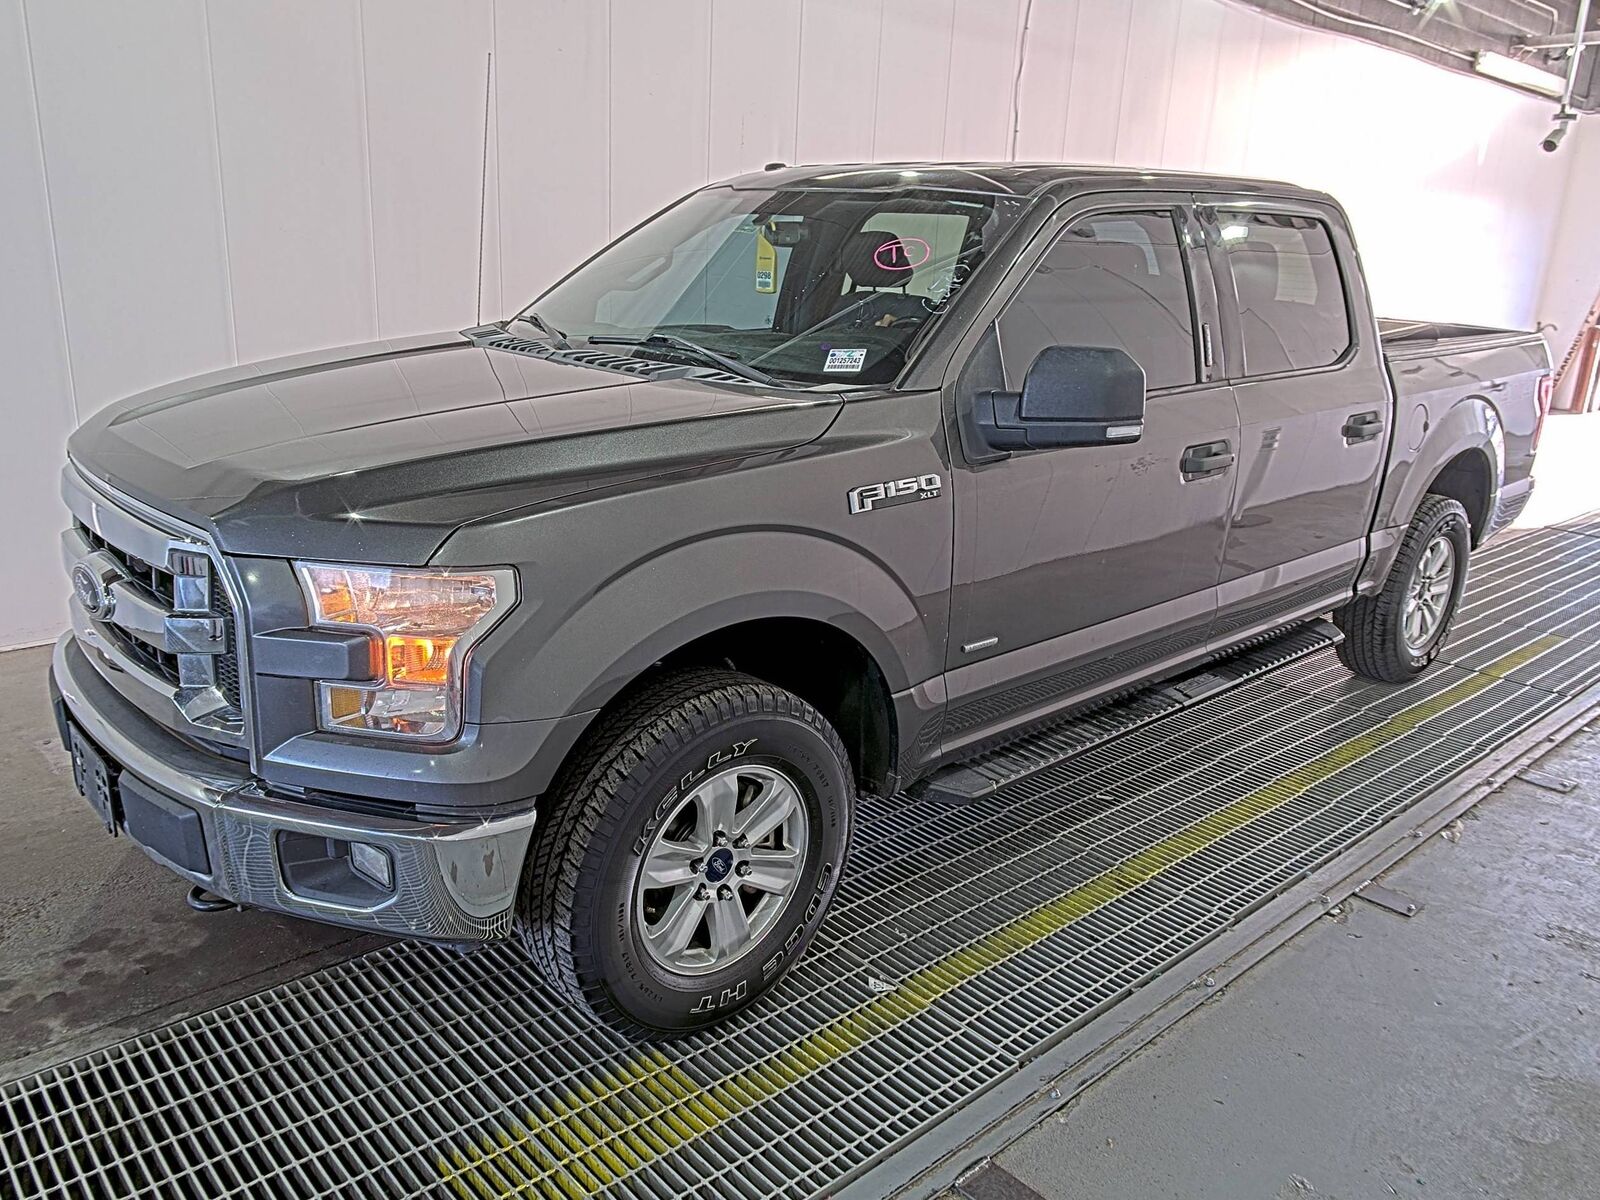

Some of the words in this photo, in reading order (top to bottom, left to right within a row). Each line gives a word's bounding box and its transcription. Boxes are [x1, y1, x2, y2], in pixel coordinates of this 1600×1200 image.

[757, 271, 772, 280] 0298
[828, 357, 862, 365] 001257243
[920, 489, 939, 500] XLT
[632, 737, 760, 857] KELLY
[761, 862, 833, 982] EDGE
[689, 980, 748, 1015] HT
